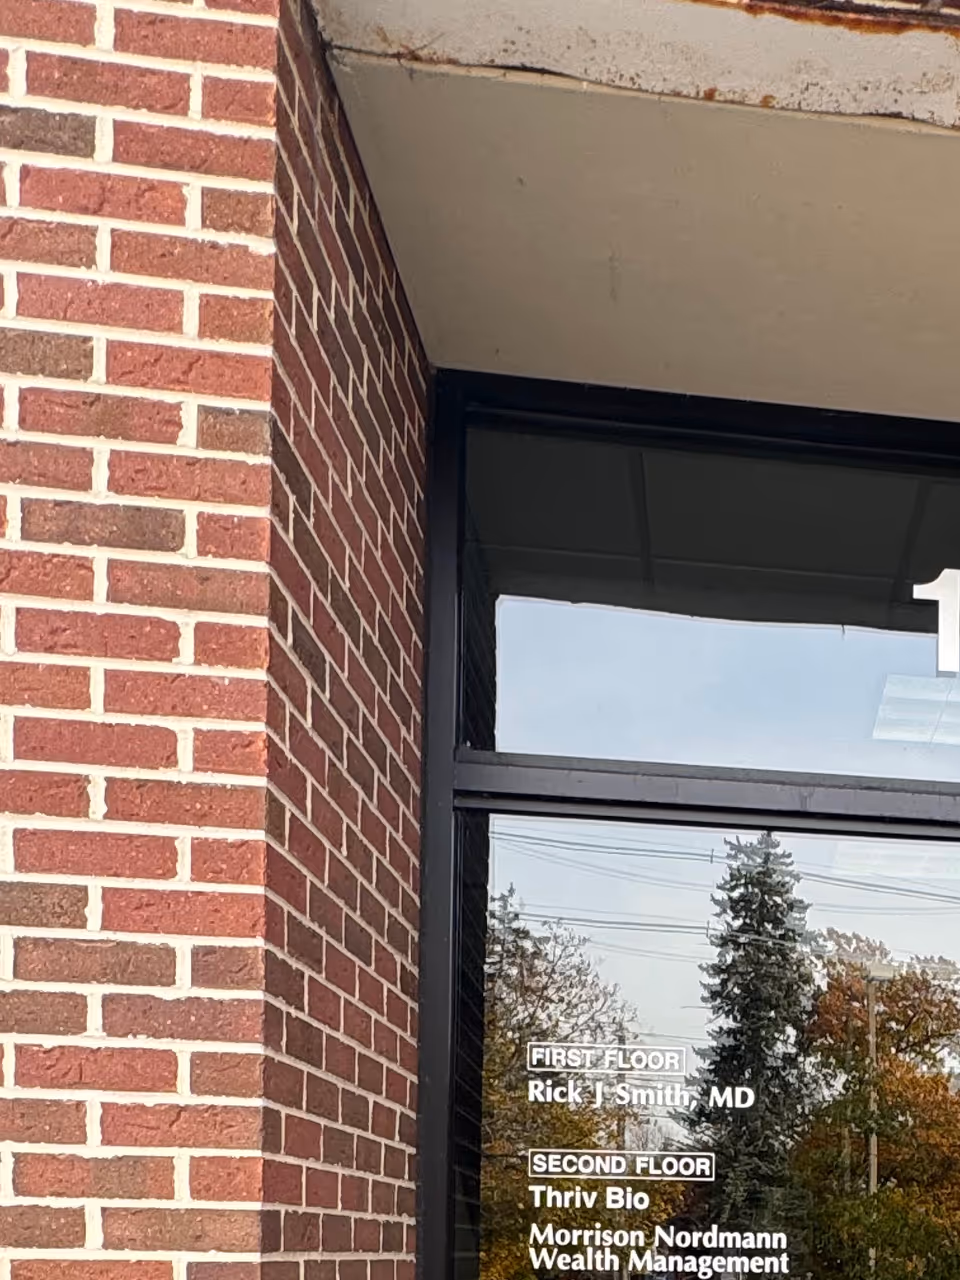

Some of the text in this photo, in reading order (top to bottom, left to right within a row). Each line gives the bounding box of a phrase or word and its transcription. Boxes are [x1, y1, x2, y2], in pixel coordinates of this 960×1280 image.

[531, 1047, 680, 1070] FIRST FLOOR
[528, 1079, 755, 1111] Rick J Smith, MD
[532, 1153, 711, 1176] SECOND FLOOR
[529, 1185, 650, 1210] Thriv Bio
[529, 1222, 788, 1250] Morrison Nordmann
[529, 1247, 790, 1280] Wealth Management
